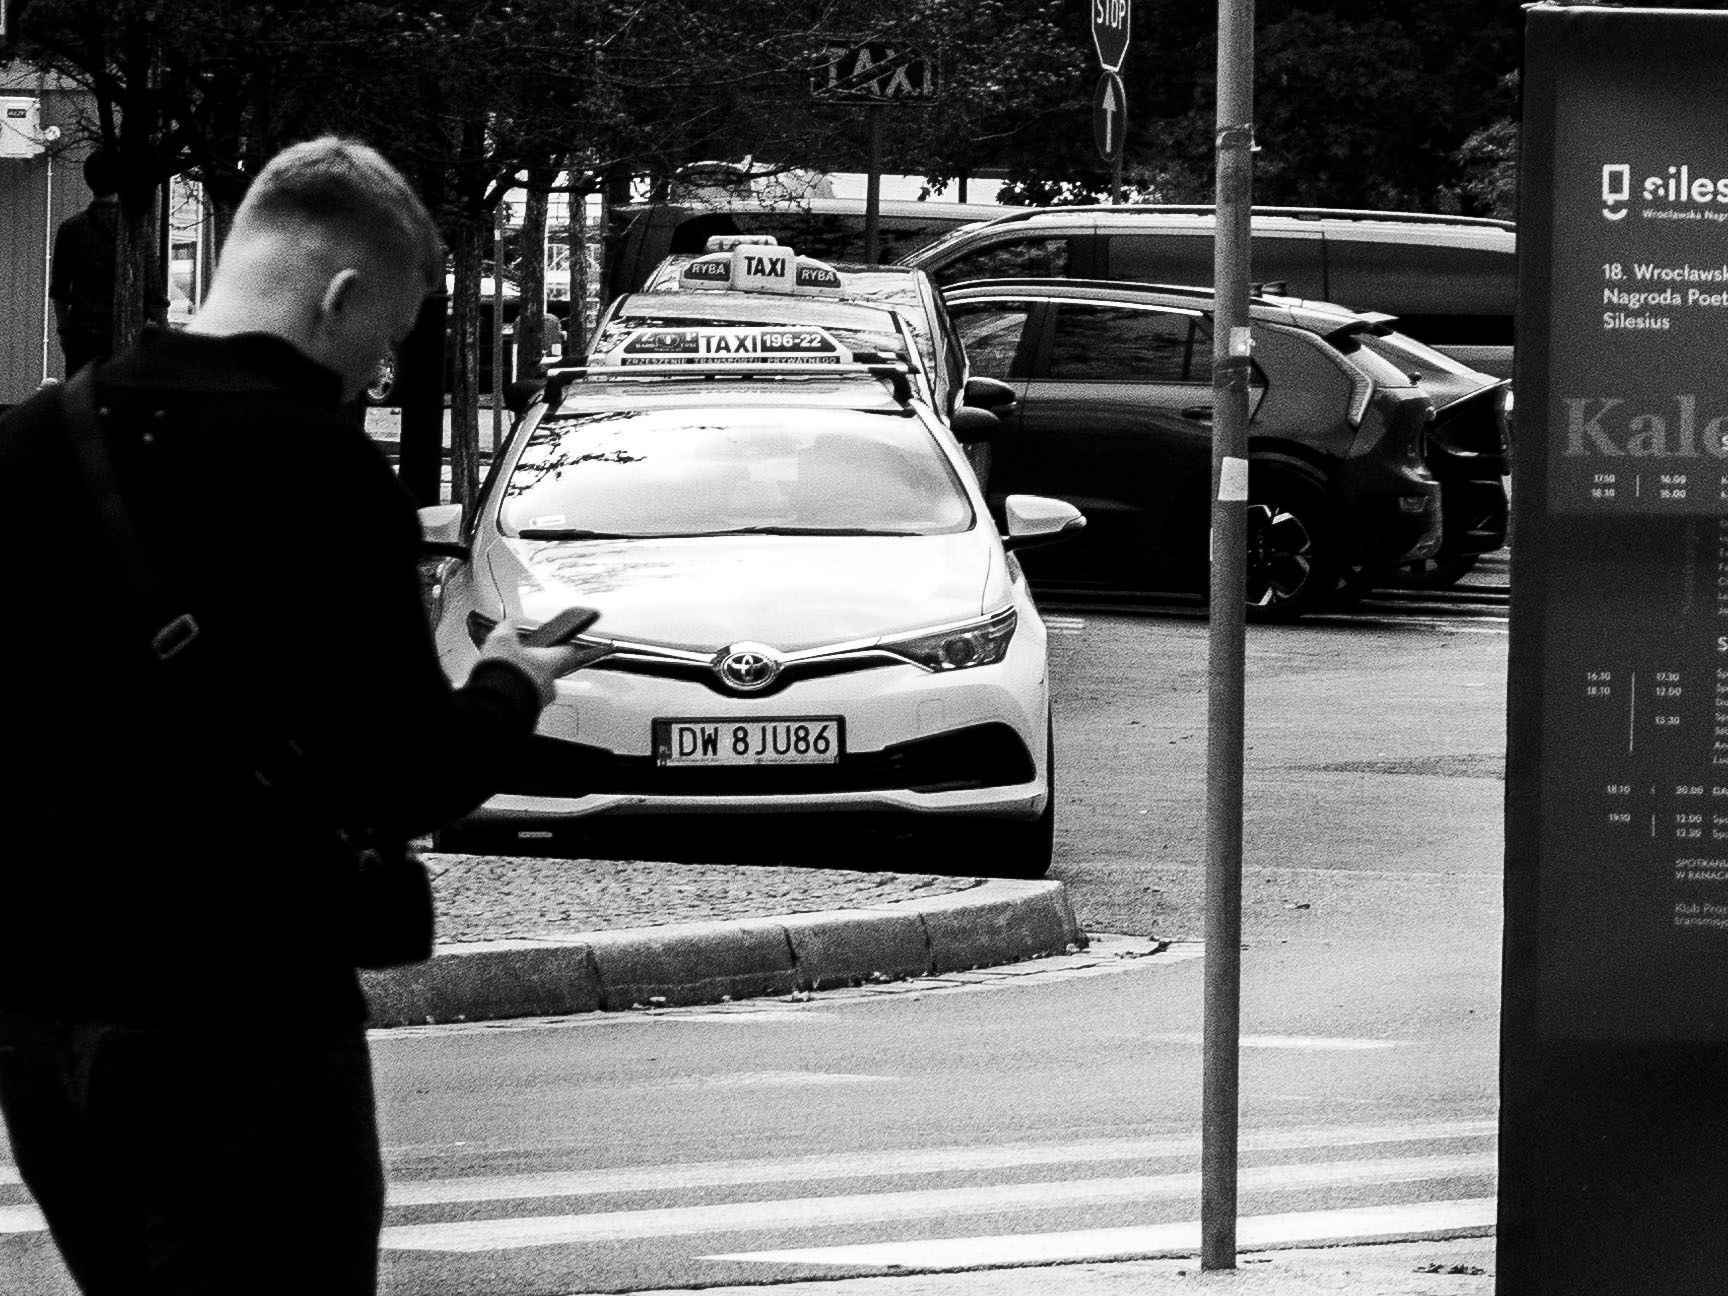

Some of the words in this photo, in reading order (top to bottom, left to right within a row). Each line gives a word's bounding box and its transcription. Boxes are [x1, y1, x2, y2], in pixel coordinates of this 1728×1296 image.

[691, 262, 726, 275] RYBA
[744, 256, 786, 278] TAXI
[801, 269, 835, 282] RYBA
[1602, 263, 1628, 281] 18.
[1603, 288, 1682, 309] Nagroda
[1603, 311, 1670, 330] Silesius
[701, 335, 757, 354] TAXI
[763, 334, 822, 348] 196-22
[678, 726, 718, 757] DW
[732, 724, 831, 756] 8JU86
